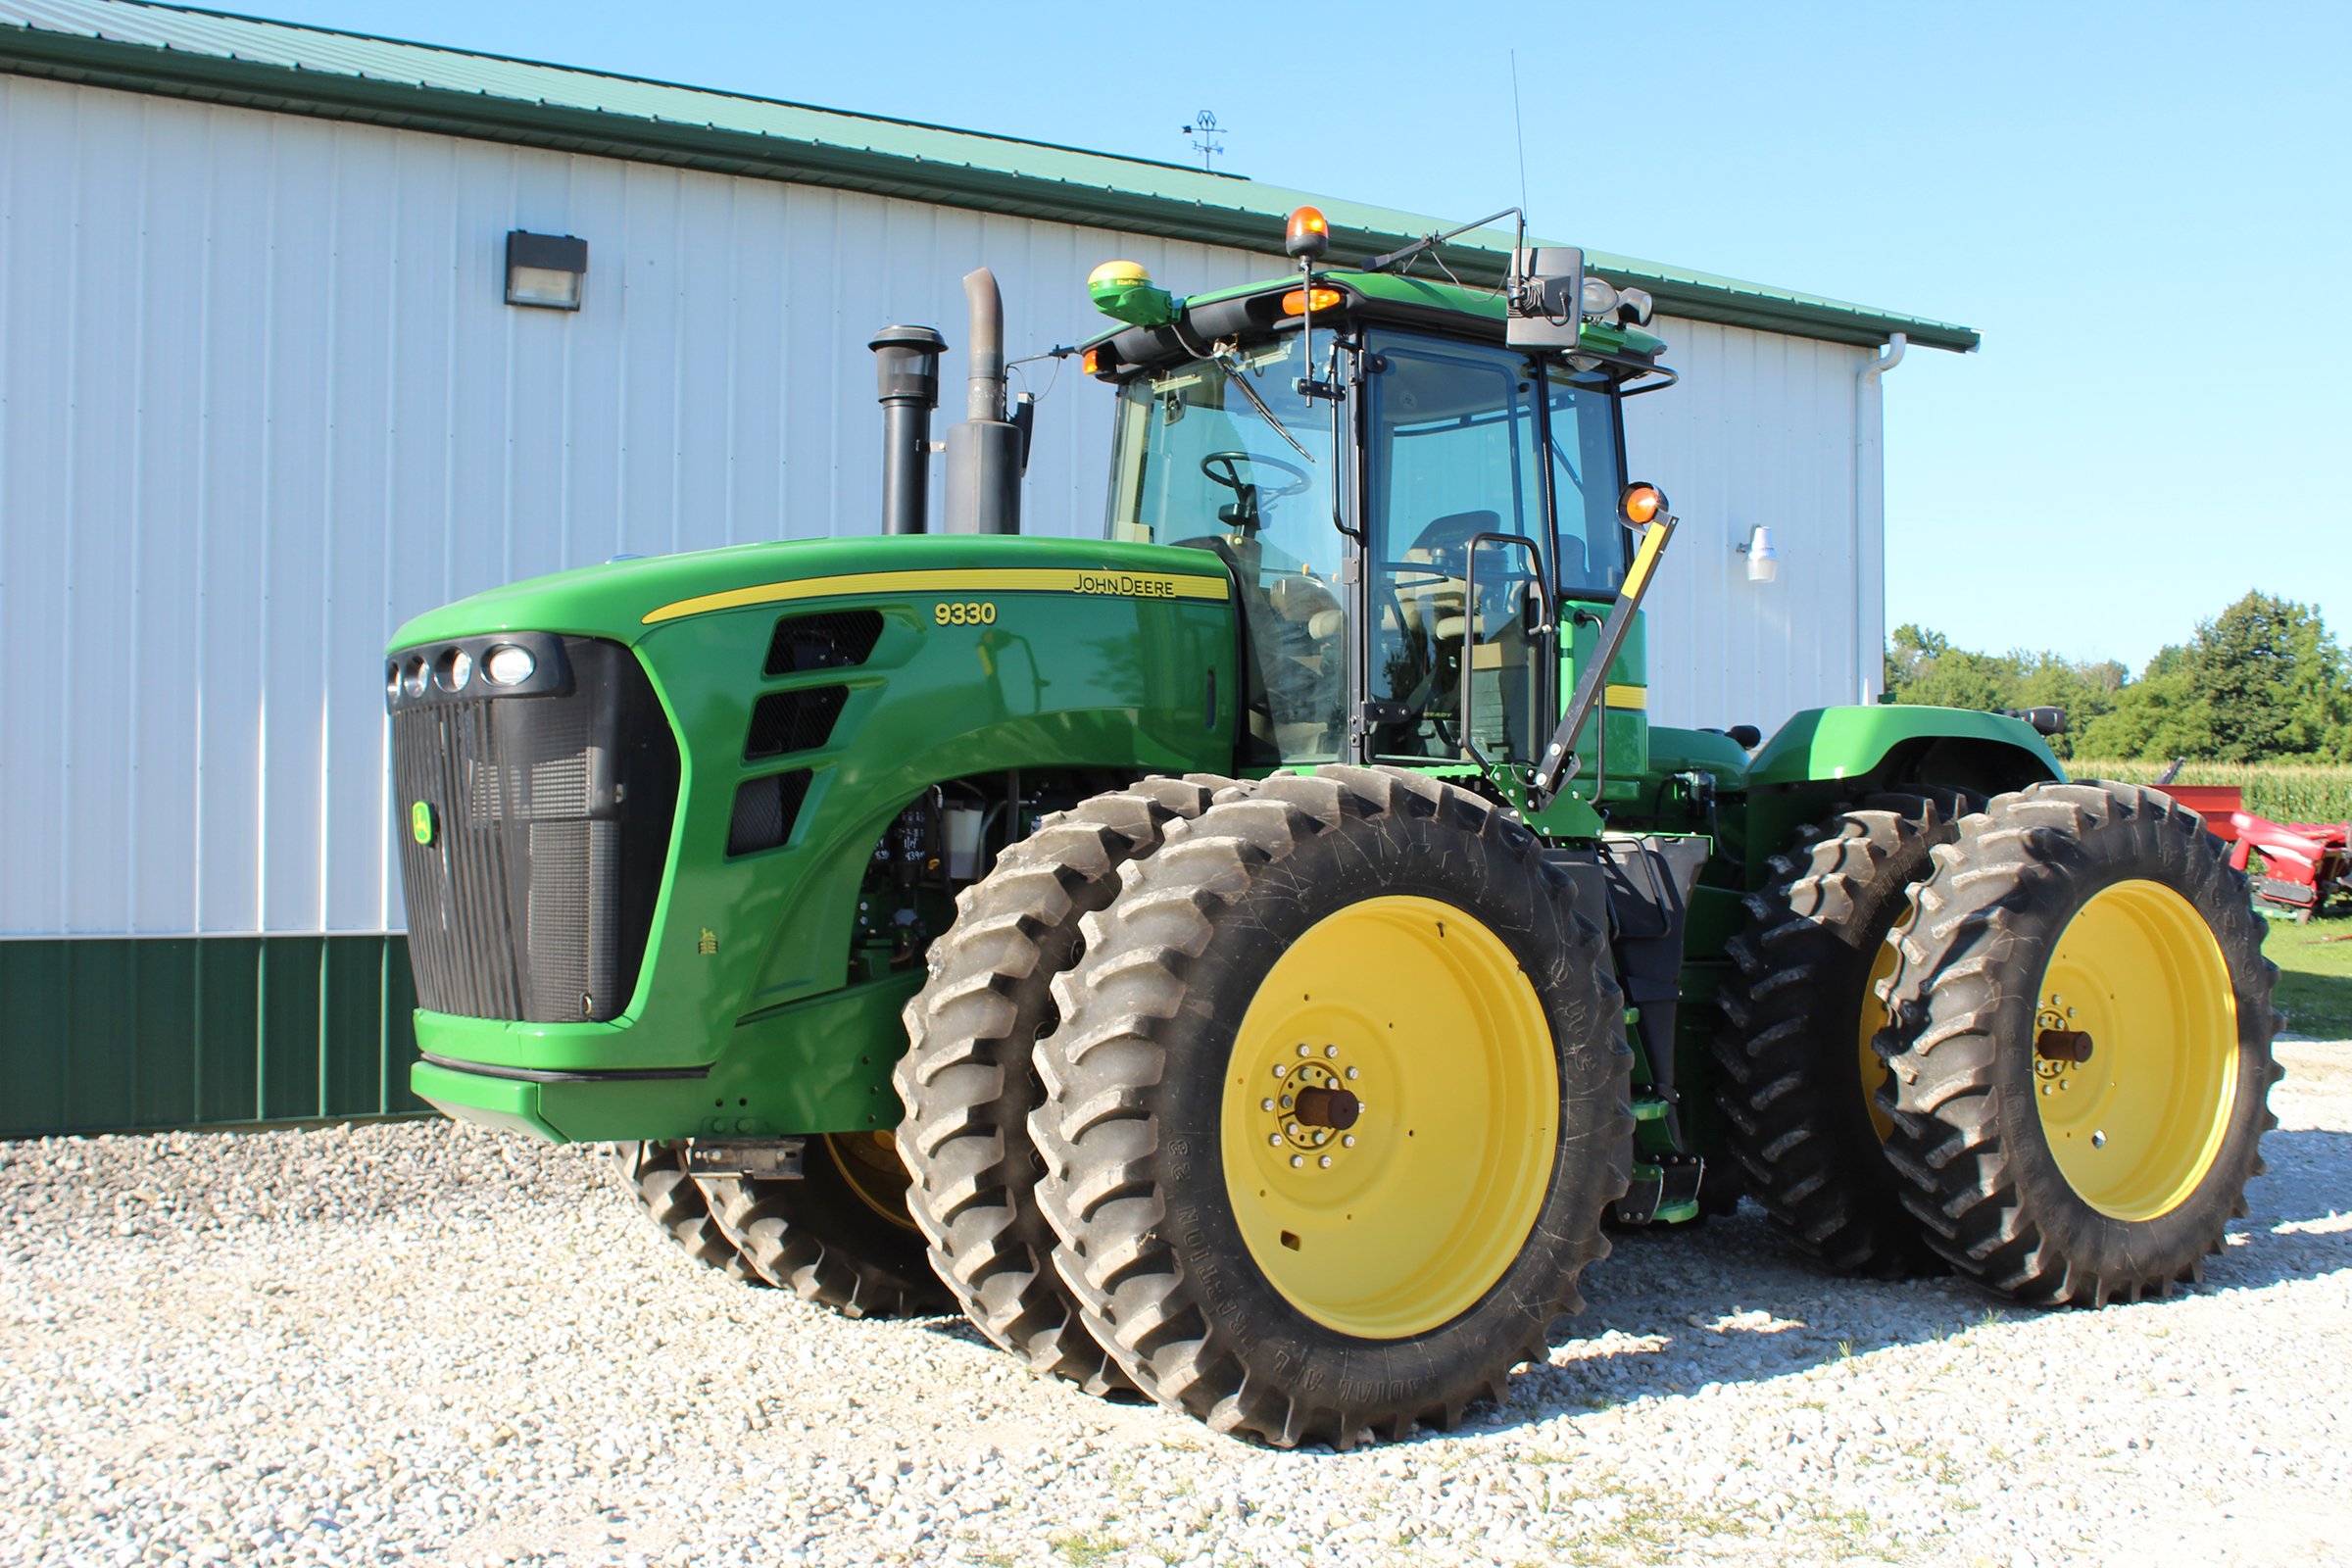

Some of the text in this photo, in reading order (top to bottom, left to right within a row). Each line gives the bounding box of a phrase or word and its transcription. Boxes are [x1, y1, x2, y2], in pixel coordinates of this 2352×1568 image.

[1074, 573, 1175, 597] JOHN DEERE
[934, 602, 997, 626] 9330
